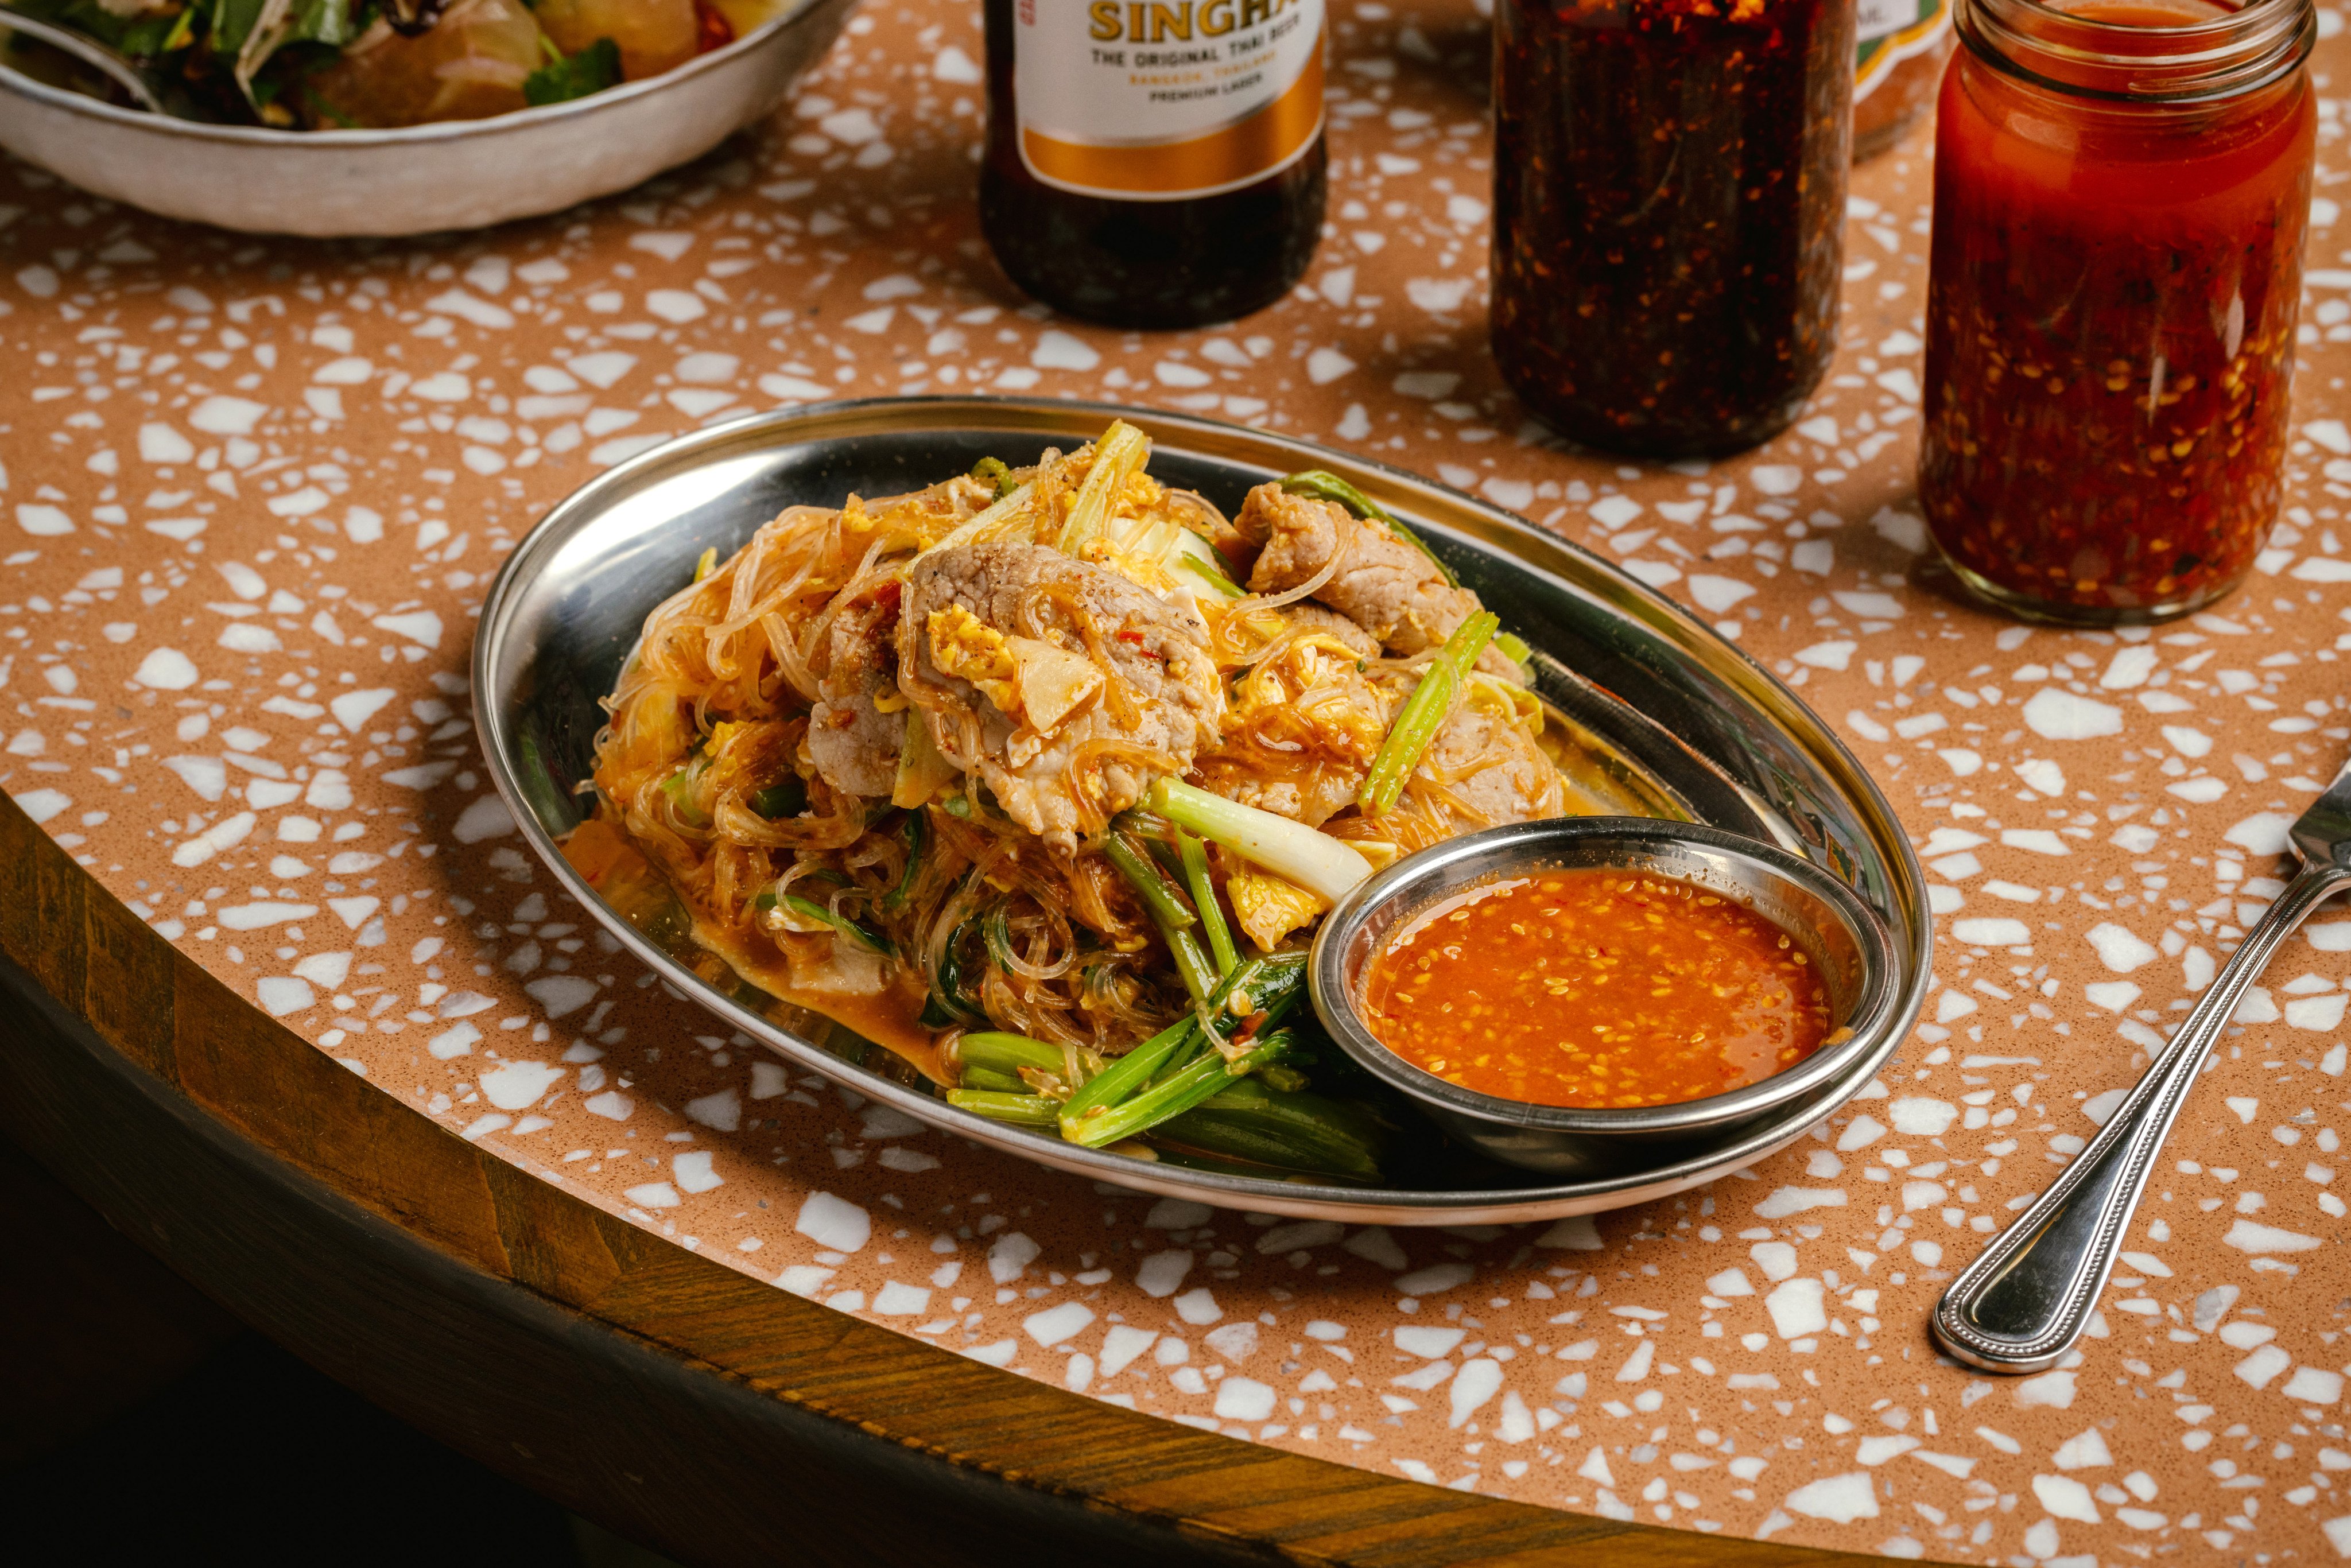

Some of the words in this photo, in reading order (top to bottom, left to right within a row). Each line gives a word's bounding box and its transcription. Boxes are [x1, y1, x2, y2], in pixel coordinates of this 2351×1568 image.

[1092, 48, 1125, 67] THE
[1134, 48, 1220, 68] ORIGINAL
[1229, 33, 1264, 57] THAI
[1150, 87, 1218, 102] PREMIUM
[1221, 71, 1262, 95] LAGER
